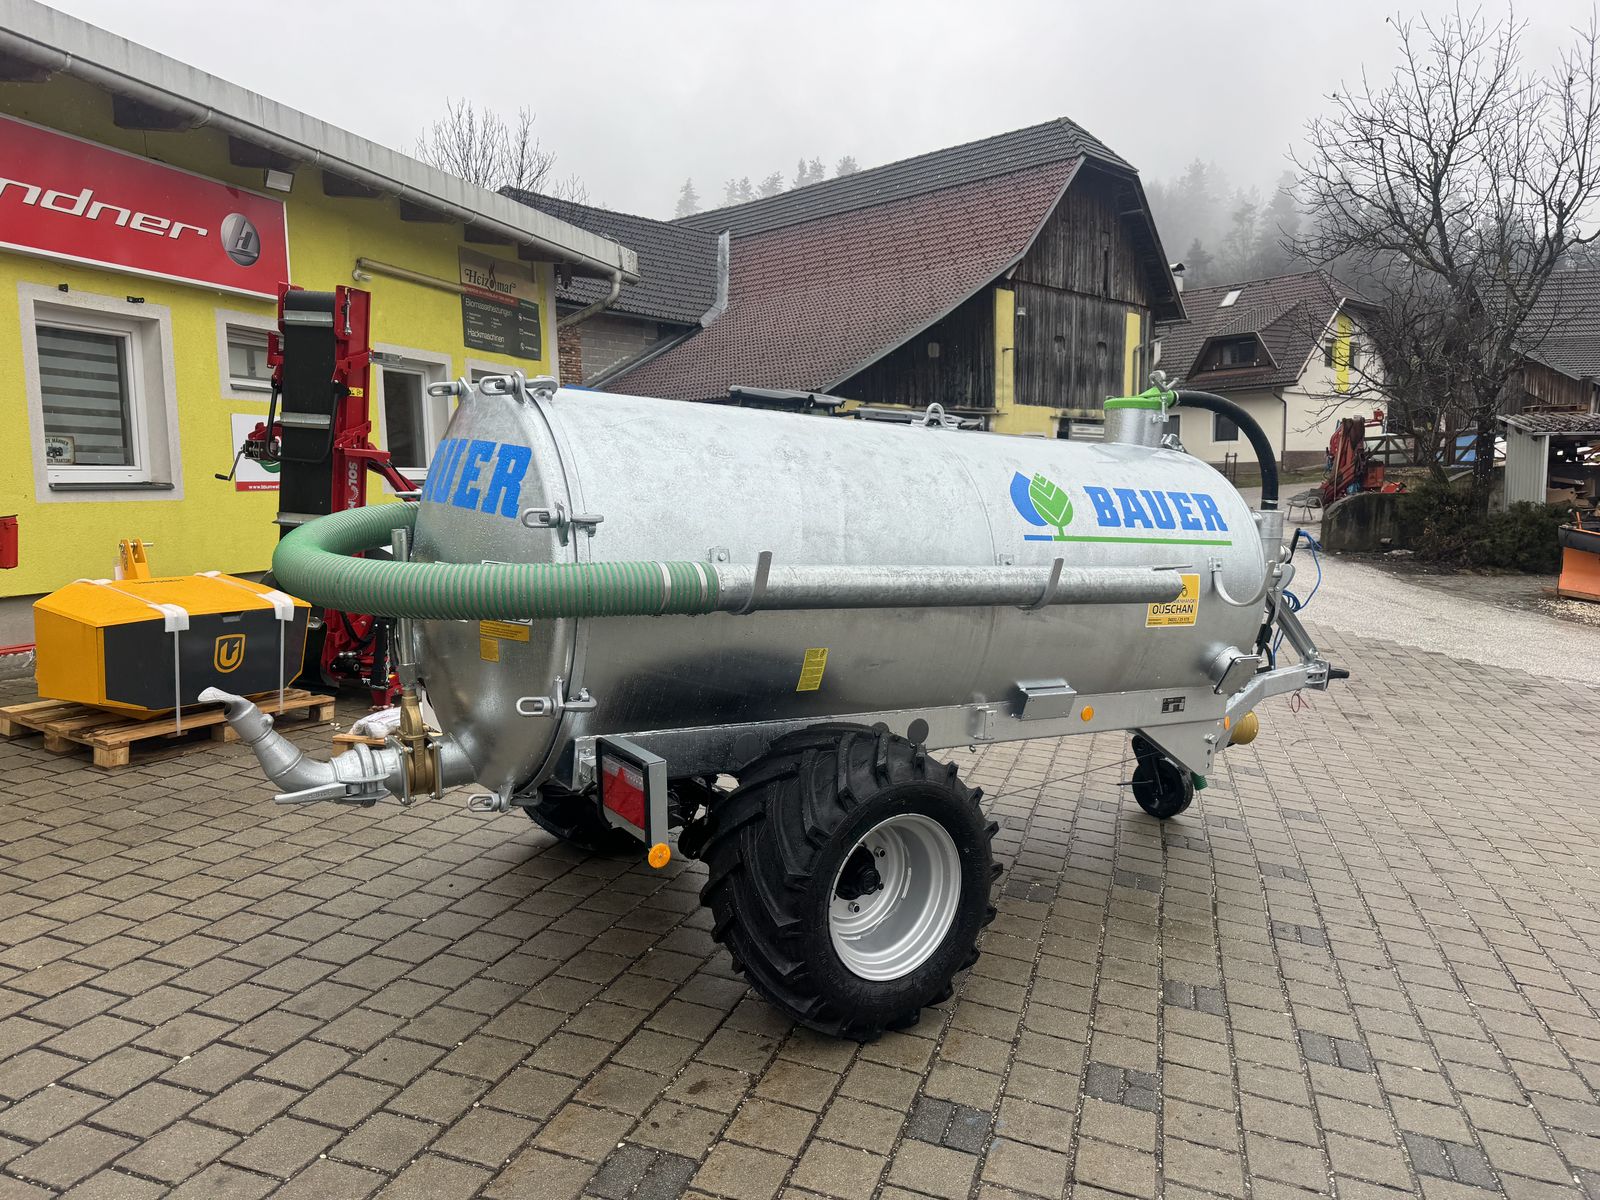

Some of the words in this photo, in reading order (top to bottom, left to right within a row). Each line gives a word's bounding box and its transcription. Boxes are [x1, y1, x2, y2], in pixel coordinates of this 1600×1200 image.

[467, 327, 505, 343] Hackmaschinen
[1083, 486, 1229, 532] BAUER
[1152, 604, 1194, 615] OUSCHAN
